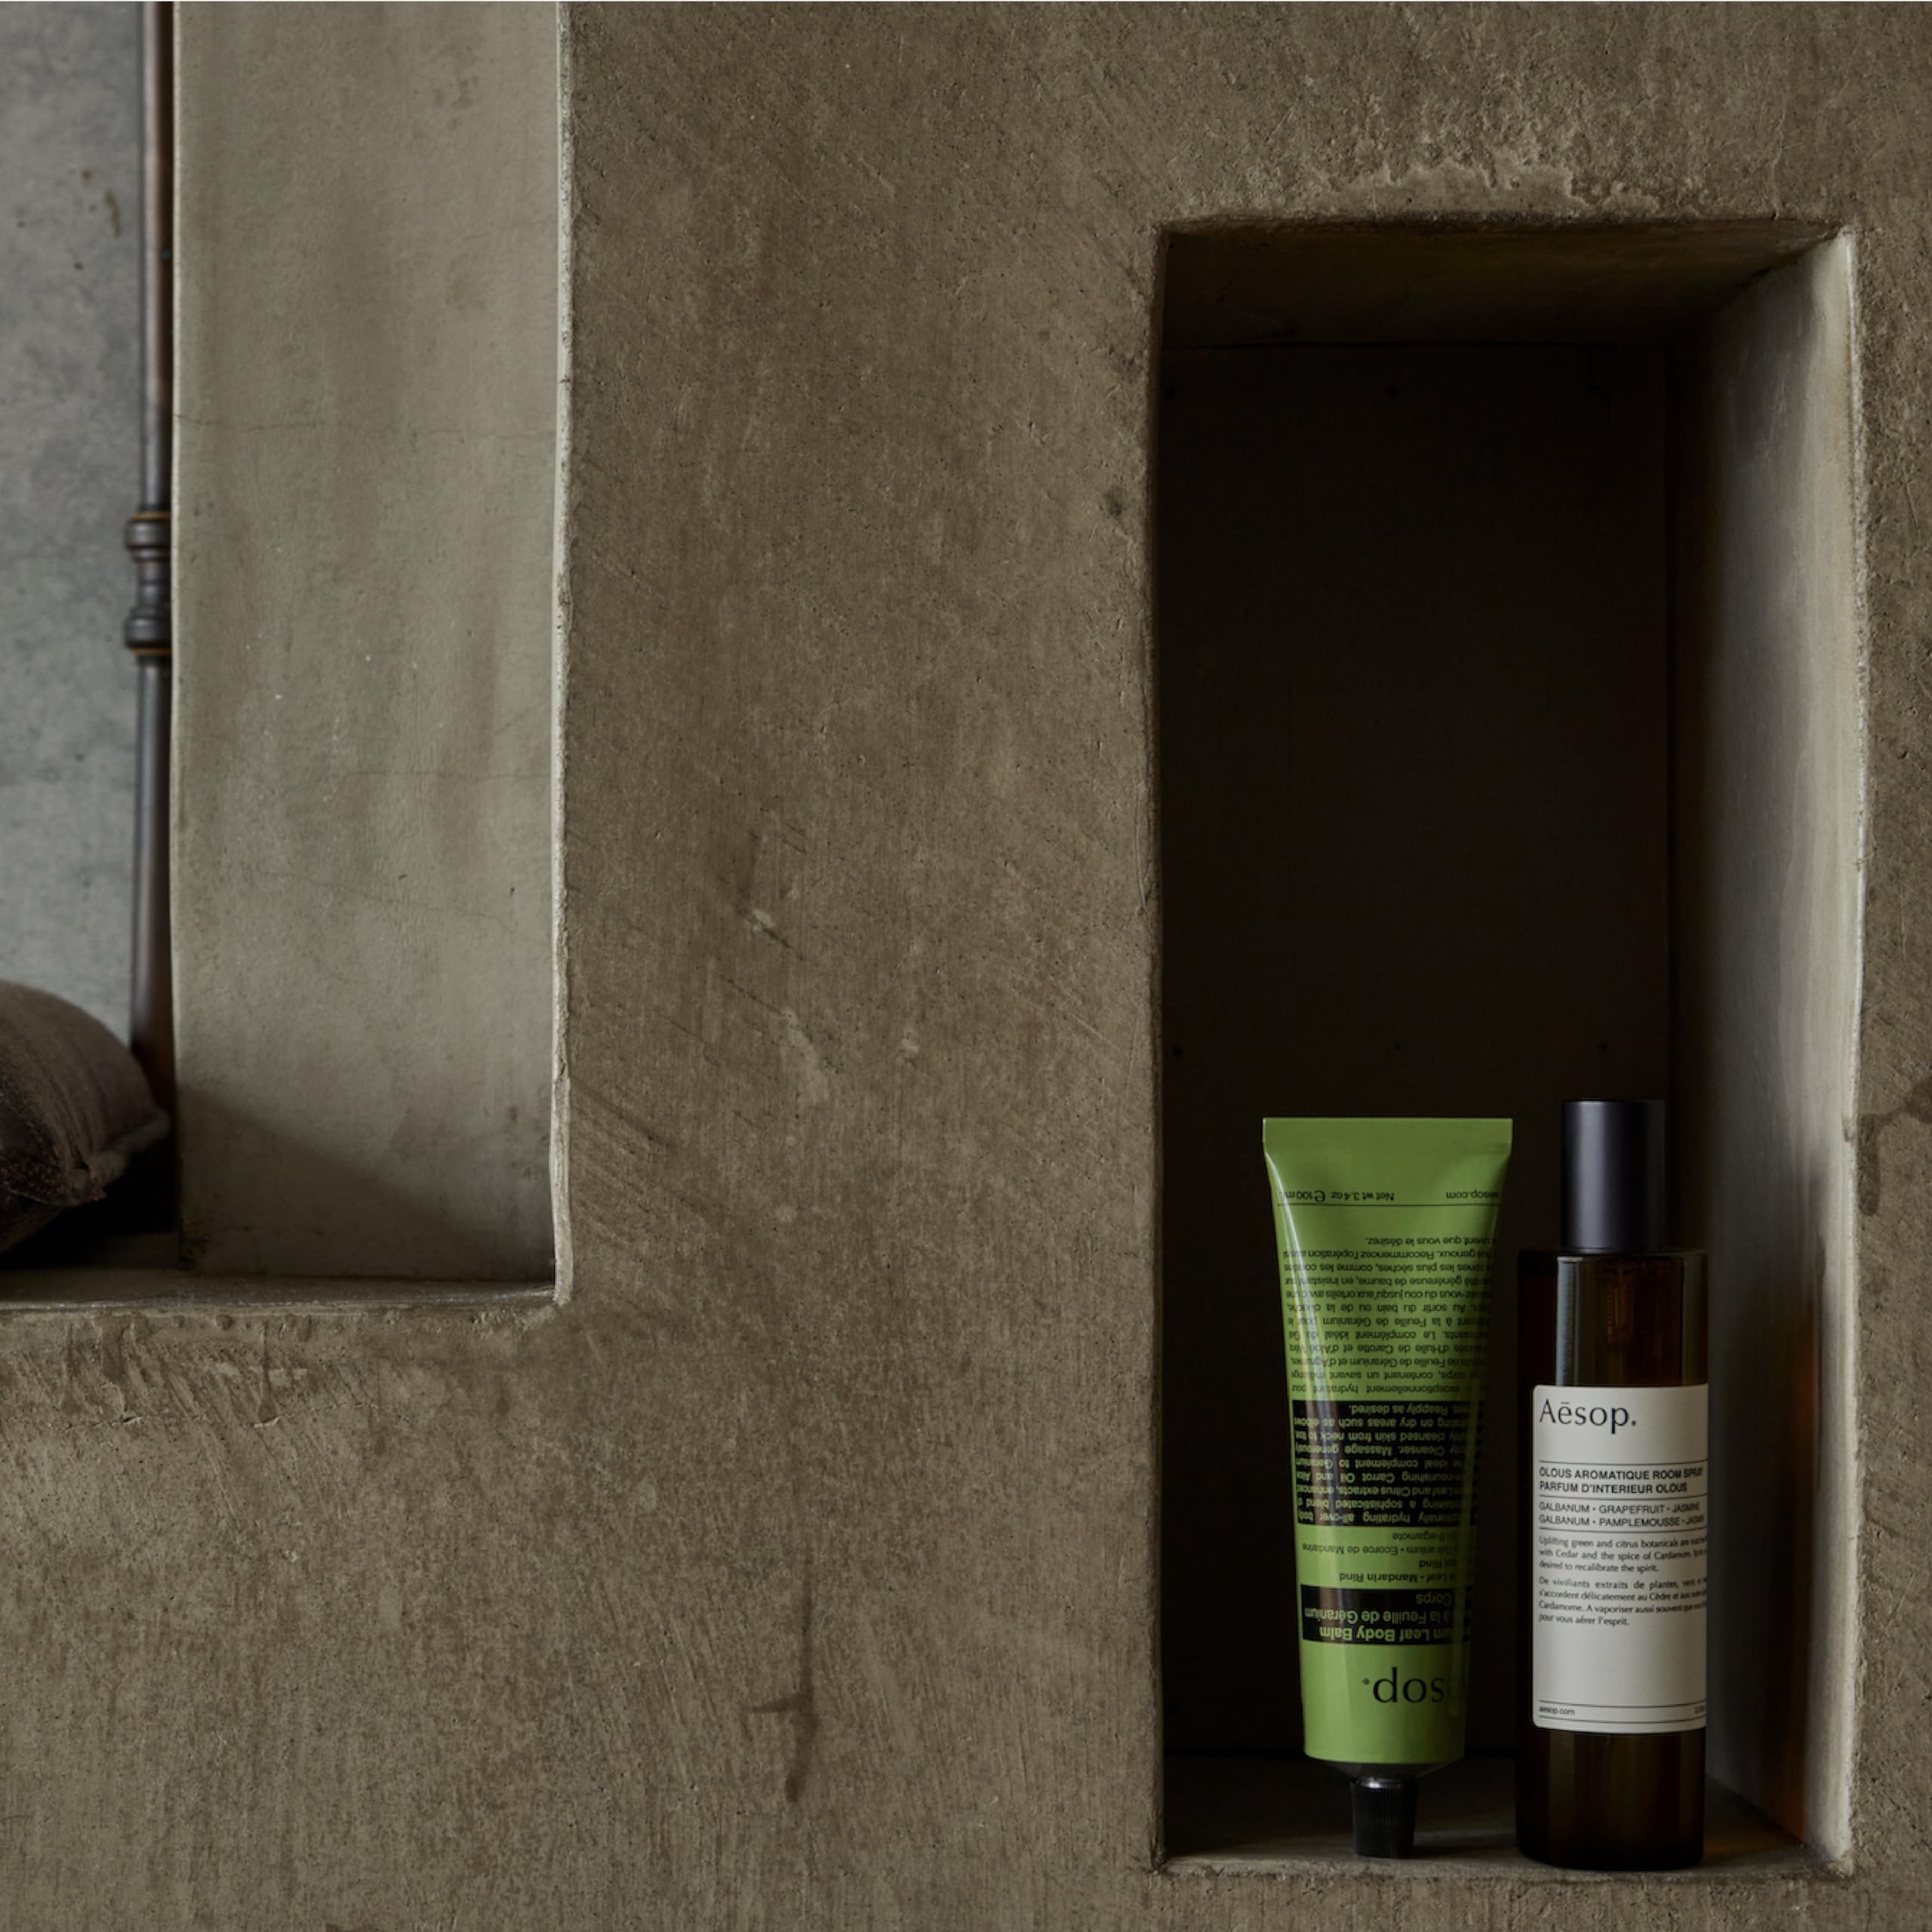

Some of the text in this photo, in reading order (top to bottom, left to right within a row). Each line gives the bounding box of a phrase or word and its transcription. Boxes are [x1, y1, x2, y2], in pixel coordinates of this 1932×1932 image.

[1345, 1192, 1360, 1200] 3.4
[1362, 1192, 1374, 1200] wt
[1377, 1192, 1395, 1200] Net
[1365, 1237, 1402, 1245] désirez.
[1405, 1237, 1414, 1245] le
[1443, 1235, 1461, 1244] que
[1309, 1248, 1358, 1259] l'opération
[1360, 1250, 1434, 1259] Recommencez
[1437, 1248, 1475, 1257] genoux.
[1320, 1263, 1334, 1272] les
[1376, 1263, 1413, 1273] sèches,
[1417, 1262, 1437, 1272] plus
[1440, 1263, 1454, 1272] les
[1357, 1276, 1392, 1286] baume,
[1395, 1277, 1407, 1286] de
[1410, 1275, 1462, 1286] généreuse
[1327, 1291, 1355, 1299] orteils
[1358, 1289, 1403, 1300] jusqu'aux
[1425, 1291, 1437, 1299] du
[1327, 1304, 1336, 1312] la
[1341, 1304, 1354, 1312] de
[1378, 1304, 1398, 1312] bain
[1404, 1304, 1416, 1312] du
[1423, 1304, 1447, 1312] sortir
[1454, 1304, 1466, 1312] Au
[1323, 1317, 1371, 1327] Géranium
[1377, 1318, 1389, 1327] de
[1395, 1318, 1426, 1327] Feuille
[1432, 1318, 1441, 1327] la
[1446, 1318, 1452, 1326] à
[1325, 1332, 1349, 1340] idéal
[1355, 1330, 1416, 1340] complément
[1424, 1332, 1435, 1340] Le
[1343, 1344, 1353, 1353] et
[1358, 1344, 1394, 1353] Carotte
[1398, 1344, 1411, 1353] de
[1349, 1358, 1397, 1367] Géranium
[1400, 1358, 1411, 1367] de
[1413, 1358, 1445, 1367] Feuille
[1349, 1404, 1390, 1414] desired.
[1407, 1403, 1448, 1414] Reapply
[1540, 1398, 1636, 1434] Aēsop.
[1339, 1419, 1364, 1427] such
[1399, 1417, 1417, 1427] dry
[1309, 1432, 1317, 1440] to
[1321, 1432, 1345, 1441] neck
[1348, 1432, 1372, 1441] from
[1376, 1432, 1396, 1441] skin
[1401, 1432, 1446, 1441] cleansed
[1345, 1444, 1392, 1454] Massage
[1398, 1446, 1444, 1455] Cleanser.
[1339, 1459, 1349, 1467] to
[1355, 1458, 1419, 1467] complement
[1316, 1472, 1334, 1481] and
[1340, 1472, 1355, 1481] Oil
[1362, 1472, 1395, 1481] Carrot
[1540, 1467, 1572, 1478] OLOUS
[1574, 1470, 1649, 1479] AROMATIQUE
[1653, 1469, 1681, 1479] ROOM
[1337, 1485, 1379, 1494] extracts,
[1380, 1486, 1411, 1495] Citrus
[1413, 1487, 1431, 1495] and
[1540, 1482, 1687, 1494] PARFUM D'INTERIEUR OLOUS
[1336, 1498, 1404, 1509] sophisticated
[1540, 1502, 1589, 1513] GALBANUM
[1599, 1505, 1664, 1514] GRAPEFRUIT
[1363, 1512, 1411, 1523] hydrating
[1540, 1515, 1680, 1527] GALBANUM PAMPLEMOUSSE
[1571, 1539, 1593, 1548] green
[1596, 1539, 1613, 1547] and
[1616, 1539, 1638, 1547] citrus
[1641, 1539, 1678, 1547] botanicals
[1347, 1546, 1359, 1554] de
[1364, 1546, 1398, 1555] Ecorce
[1555, 1549, 1578, 1558] Cedar
[1582, 1551, 1597, 1559] and
[1601, 1551, 1614, 1559] the
[1618, 1552, 1639, 1561] spice
[1643, 1551, 1651, 1560] of
[1575, 1563, 1618, 1572] recalibrate
[1621, 1564, 1634, 1572] the
[1637, 1564, 1658, 1574] spirit.
[1340, 1573, 1364, 1582] Rind
[1367, 1573, 1417, 1582] Mandarin
[1552, 1578, 1589, 1587] vivifiants
[1595, 1580, 1628, 1589] extraits
[1415, 1592, 1452, 1606] Corps
[1581, 1592, 1635, 1601] délicatement
[1594, 1605, 1632, 1614] vaporiser
[1304, 1607, 1441, 1624] la Feuille de Géranium
[1575, 1615, 1595, 1624] aérer
[1599, 1616, 1629, 1626] l'esprit.
[1319, 1626, 1352, 1640] Balm
[1356, 1626, 1395, 1641] Body
[1398, 1629, 1430, 1641] Leaf
